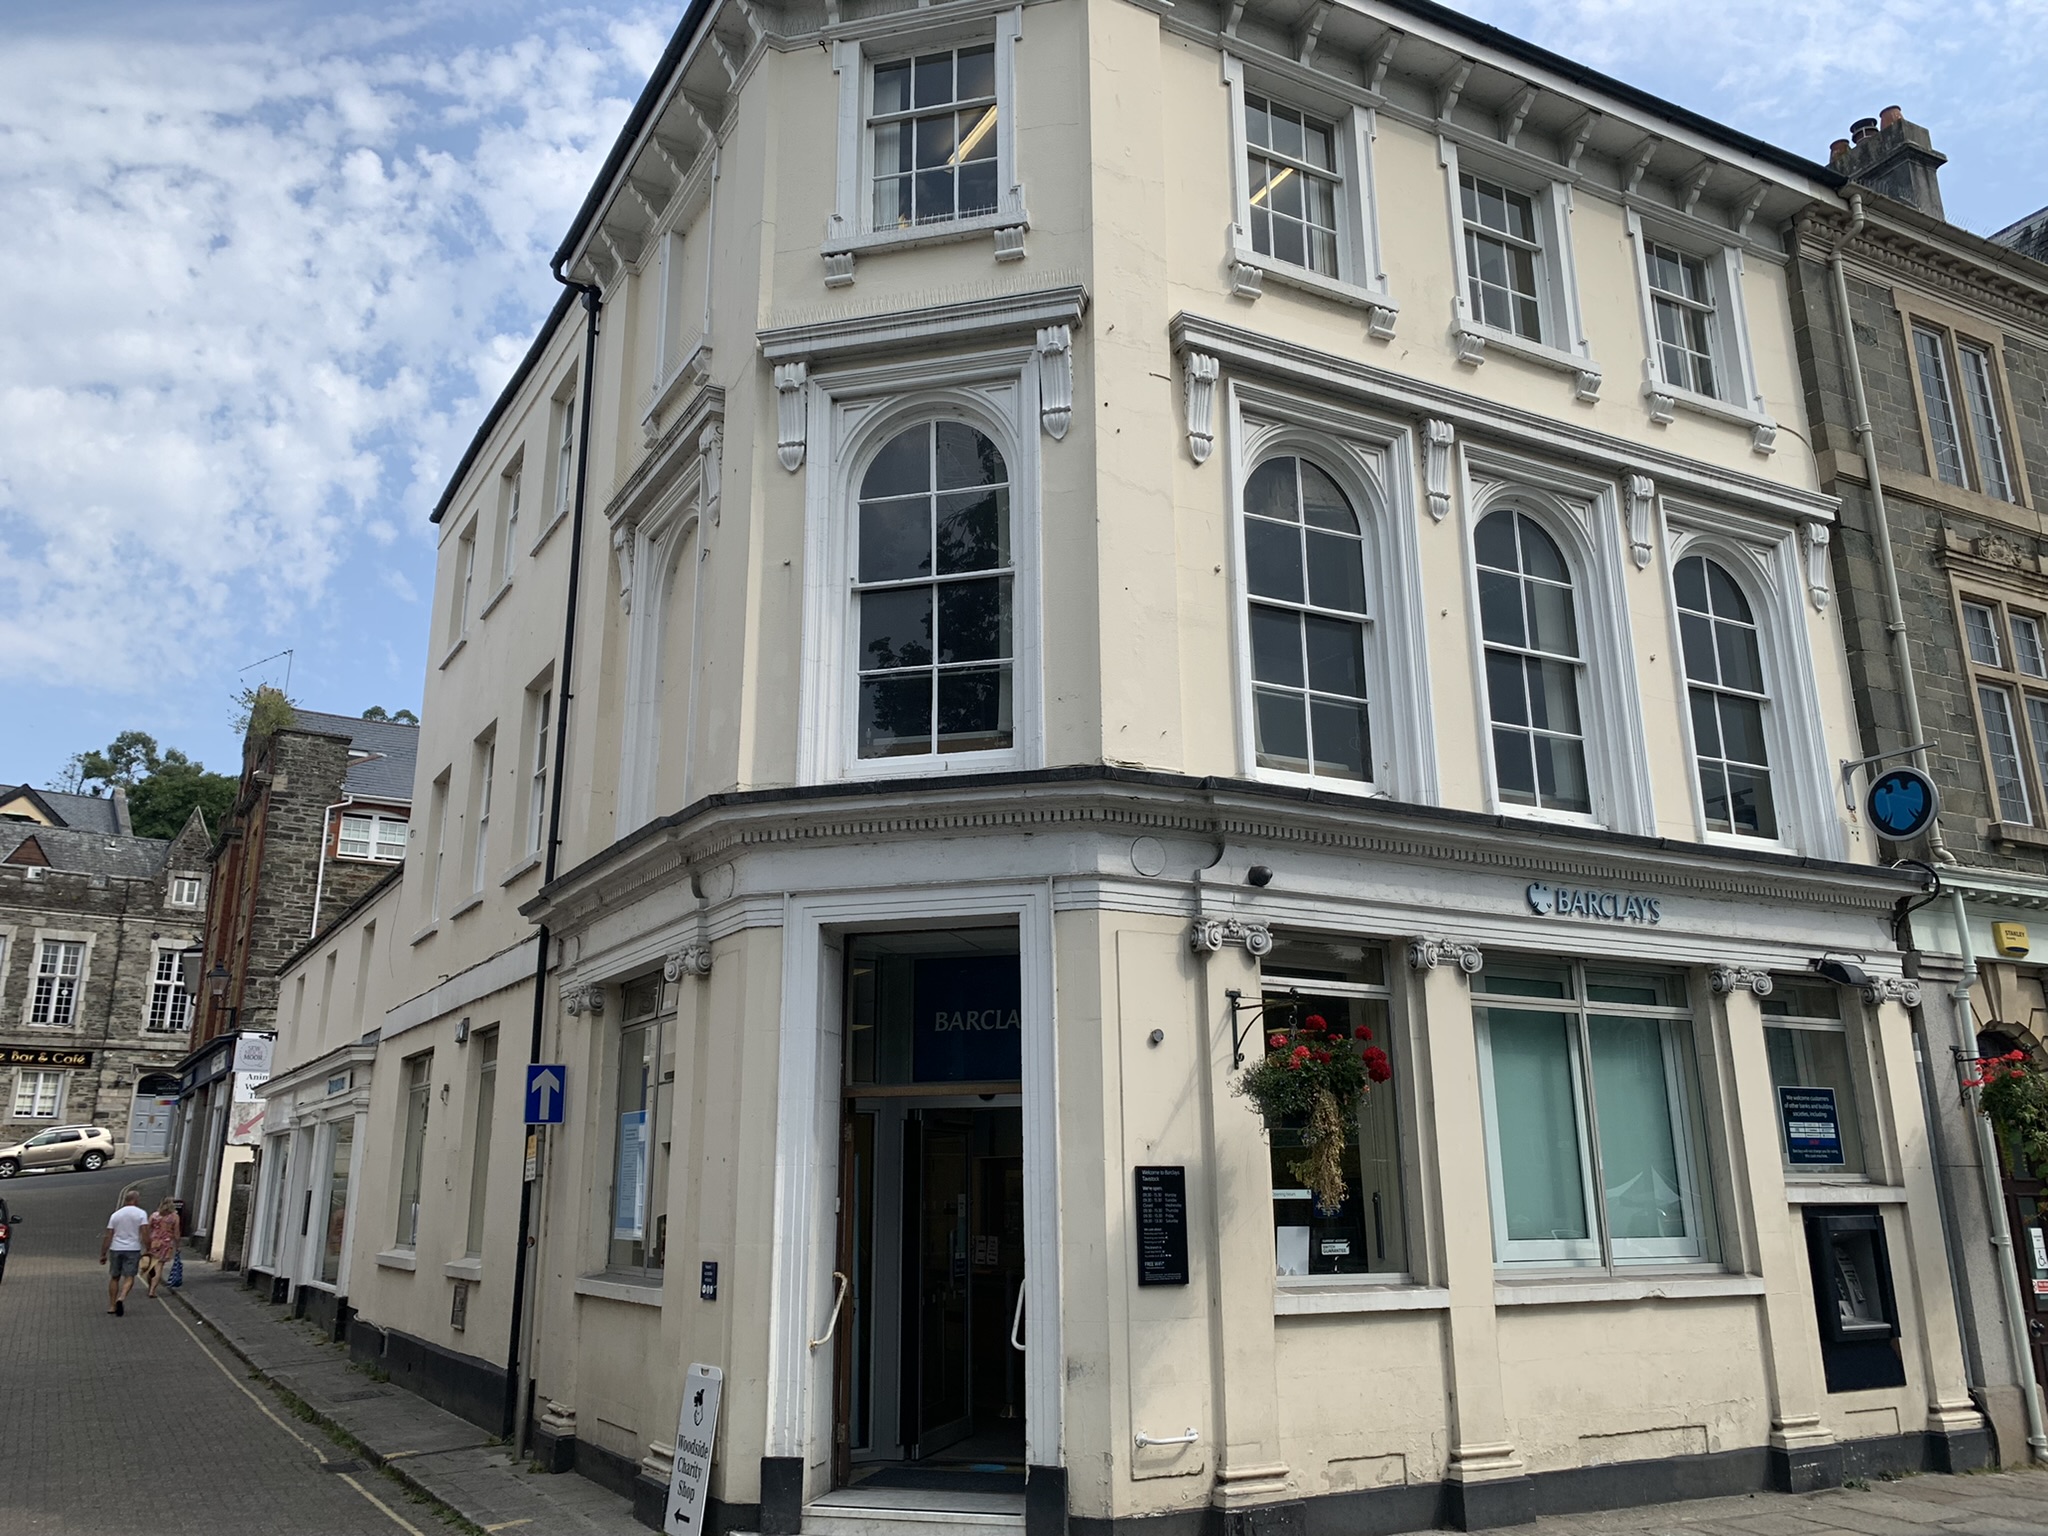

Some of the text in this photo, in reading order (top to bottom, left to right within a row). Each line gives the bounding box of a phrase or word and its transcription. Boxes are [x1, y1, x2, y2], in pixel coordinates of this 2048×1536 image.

[1556, 887, 1662, 923] BARCLAYS
[935, 1008, 1021, 1032] BARCLA
[11, 1050, 35, 1062] Bar
[38, 1052, 48, 1063] &
[52, 1052, 86, 1064] Café
[677, 1434, 709, 1460] Woodside
[677, 1456, 703, 1483] Charity
[677, 1480, 695, 1504] Shop
